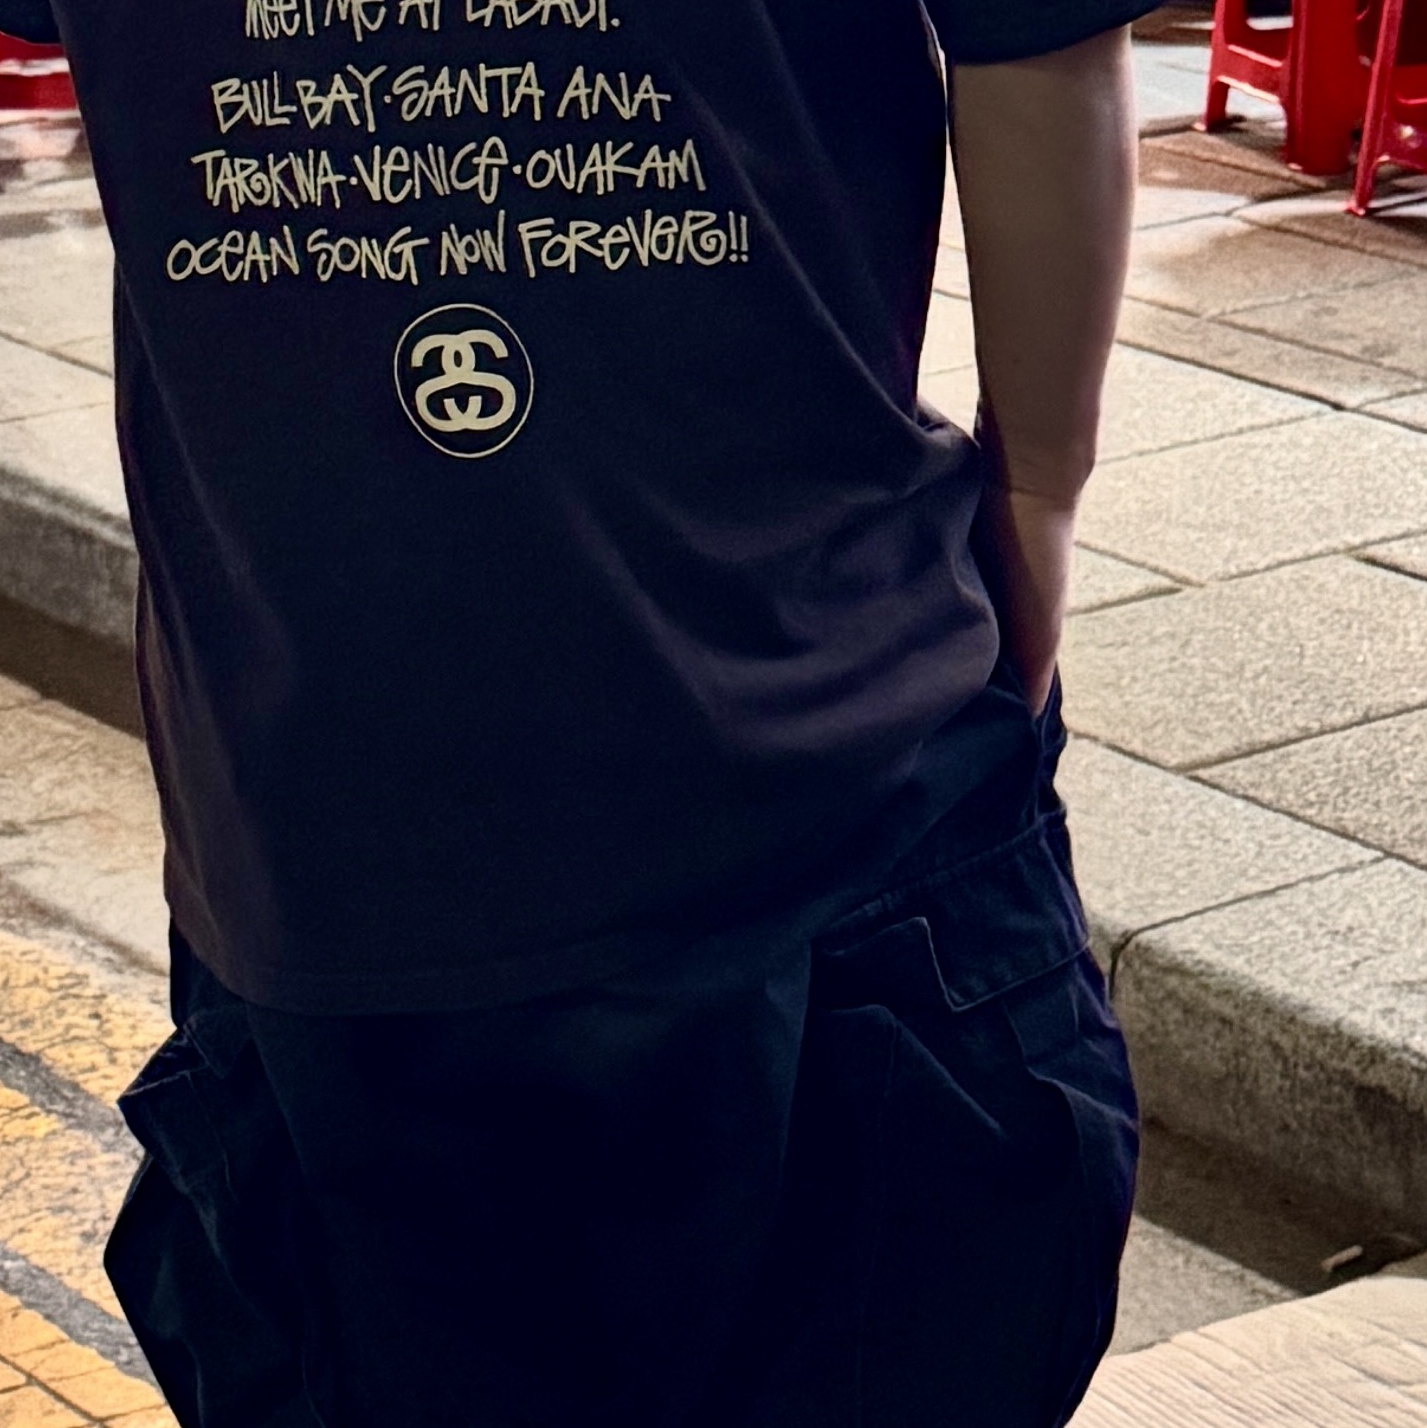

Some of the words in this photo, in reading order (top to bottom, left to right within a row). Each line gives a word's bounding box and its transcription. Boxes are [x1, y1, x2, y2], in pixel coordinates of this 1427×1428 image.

[557, 66, 671, 121] ANA
[167, 225, 299, 283] OCEAN
[307, 226, 429, 285] SONG
[440, 210, 506, 275] NOW
[518, 209, 748, 277] FOREVER!!
